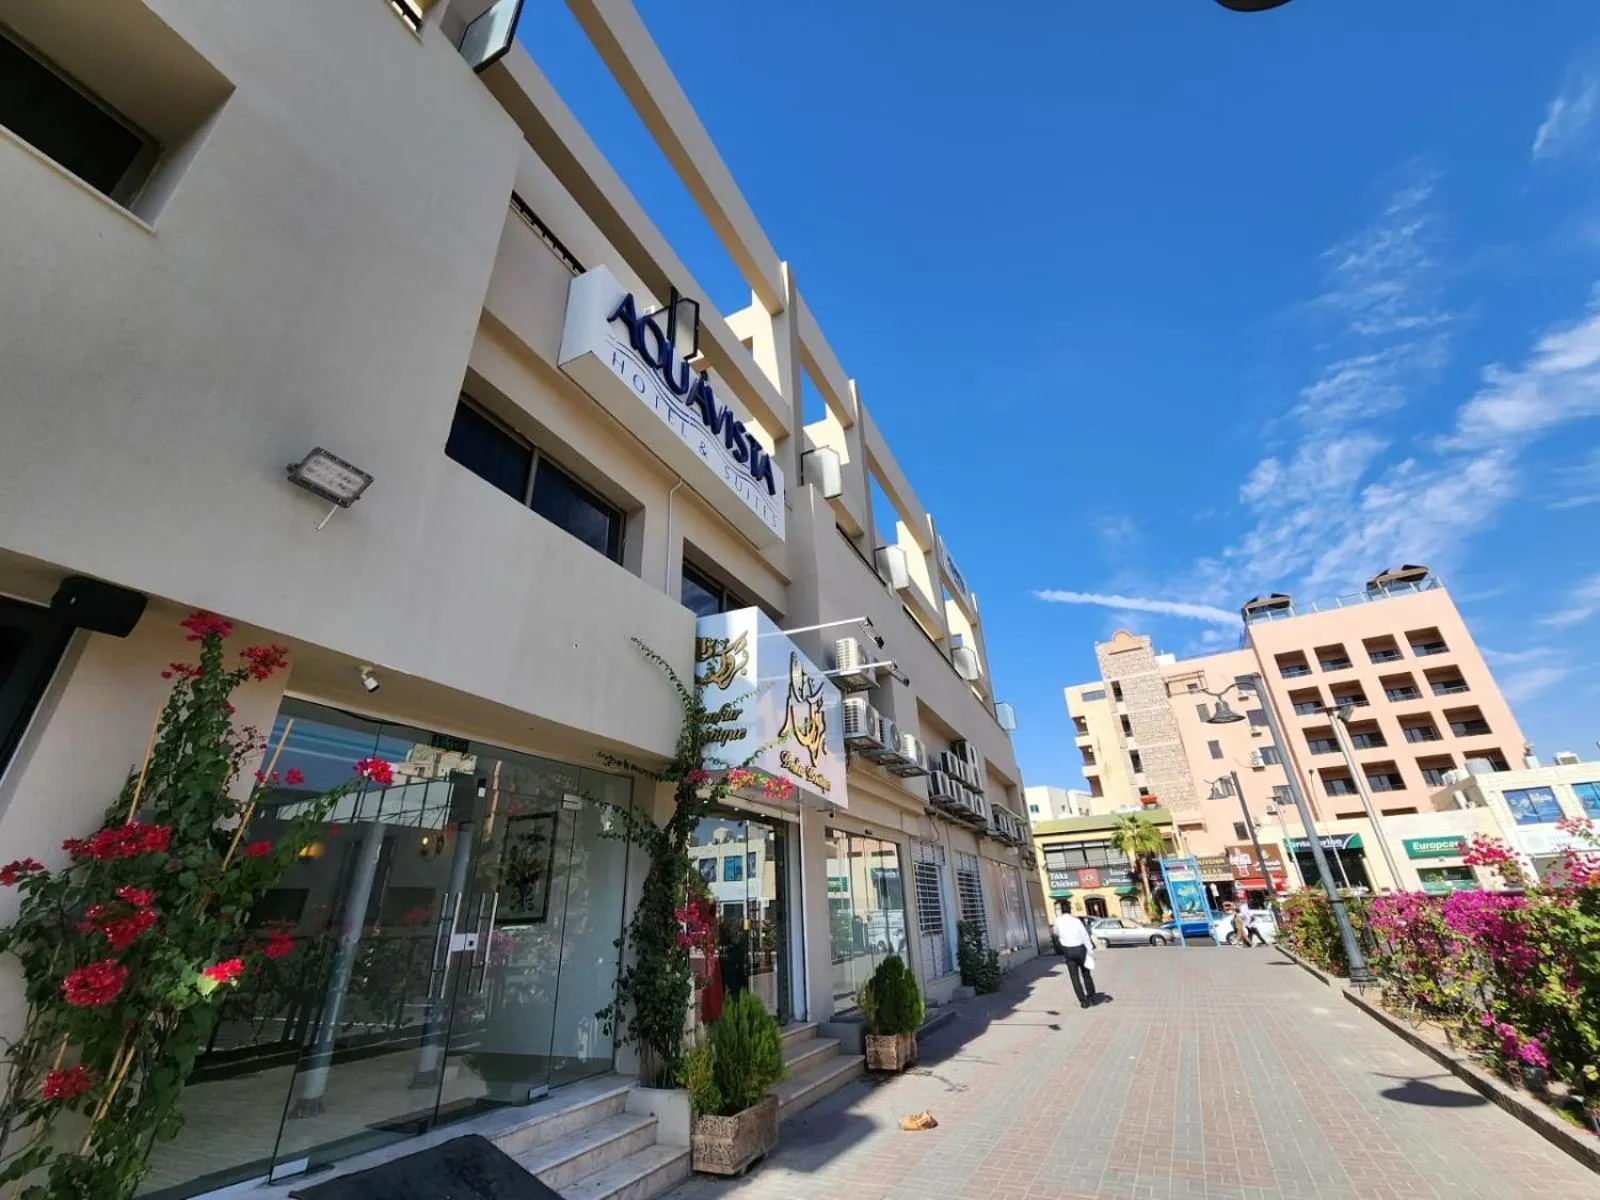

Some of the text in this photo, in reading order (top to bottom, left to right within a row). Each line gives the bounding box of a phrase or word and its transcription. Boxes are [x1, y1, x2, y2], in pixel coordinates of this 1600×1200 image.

[607, 293, 776, 496] AQUAVISTA
[611, 351, 778, 528] HOTEL & SUITES
[1049, 872, 1069, 880] Tikka
[1051, 880, 1080, 889] Chicken
